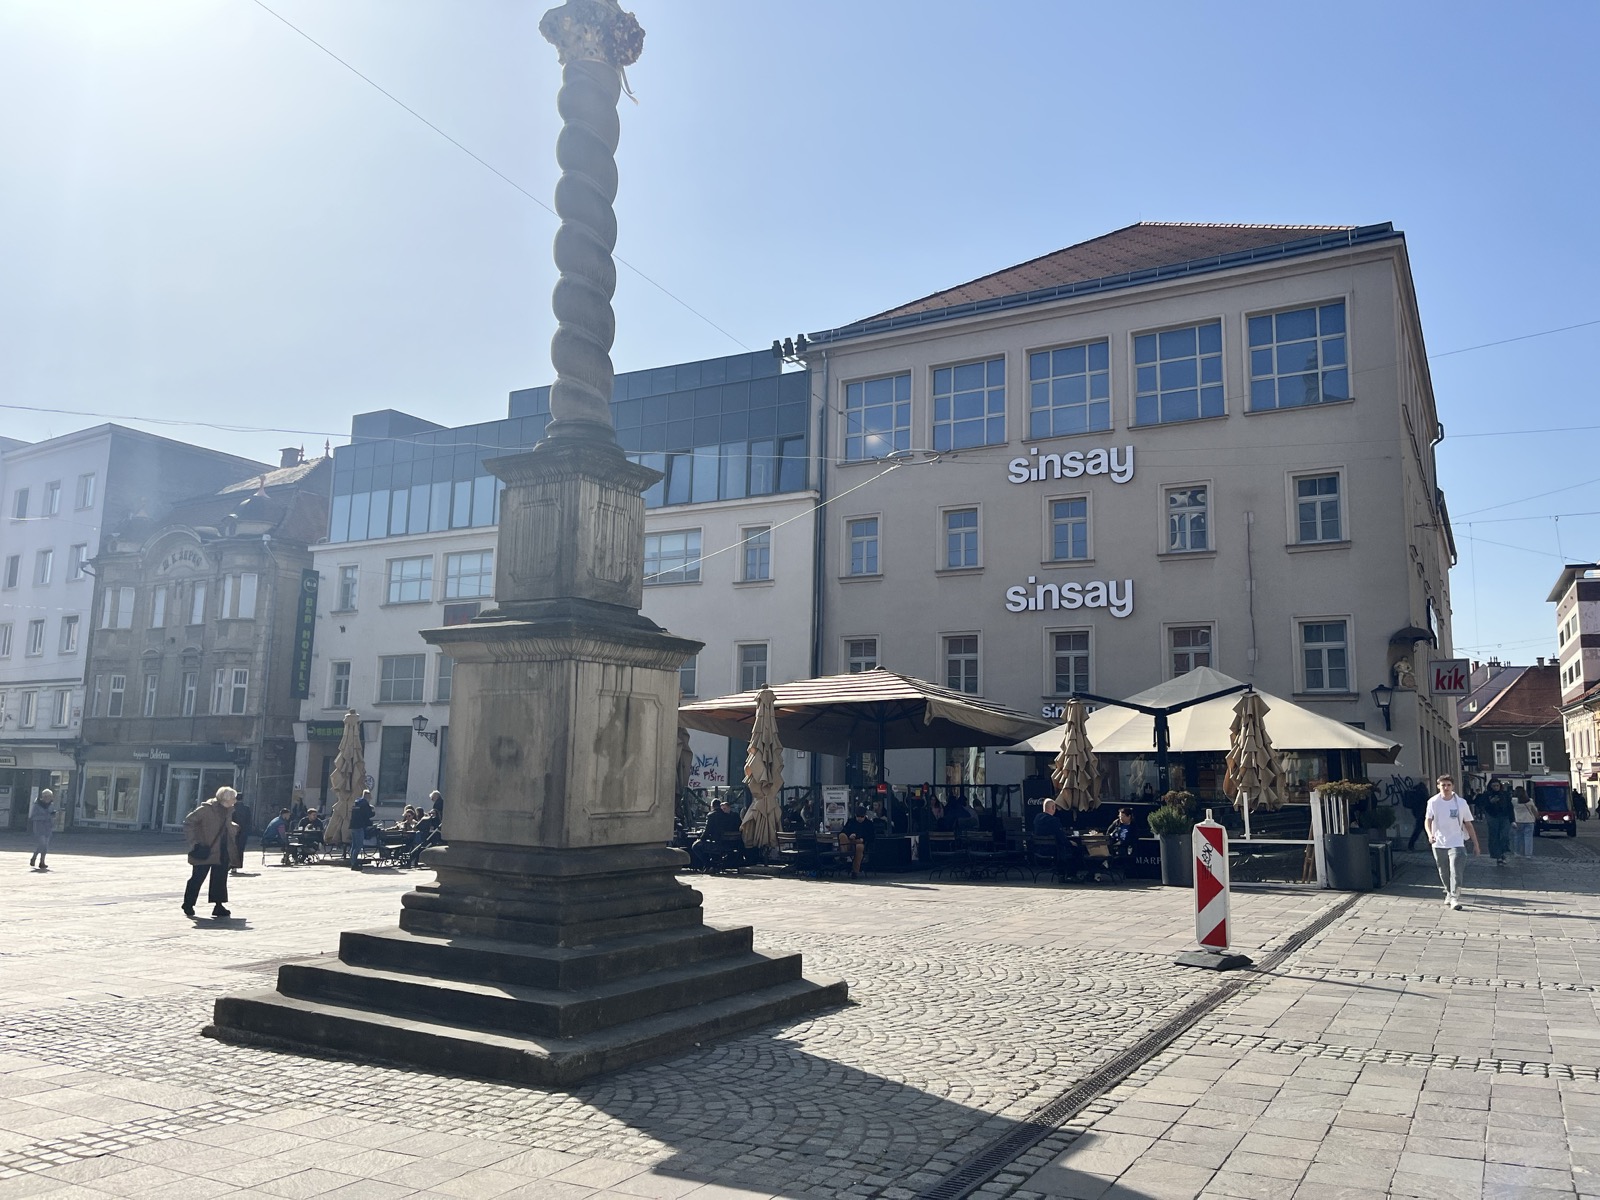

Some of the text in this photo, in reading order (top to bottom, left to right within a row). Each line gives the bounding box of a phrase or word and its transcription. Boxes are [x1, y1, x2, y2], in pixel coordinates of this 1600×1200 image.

[1007, 445, 1135, 484] sinsay
[1005, 576, 1135, 618] sinsay
[298, 630, 311, 691] HOTELS
[1435, 664, 1465, 690] kik
[1042, 703, 1096, 718] sin
[695, 754, 719, 768] NEA
[1135, 856, 1161, 865] MARP
